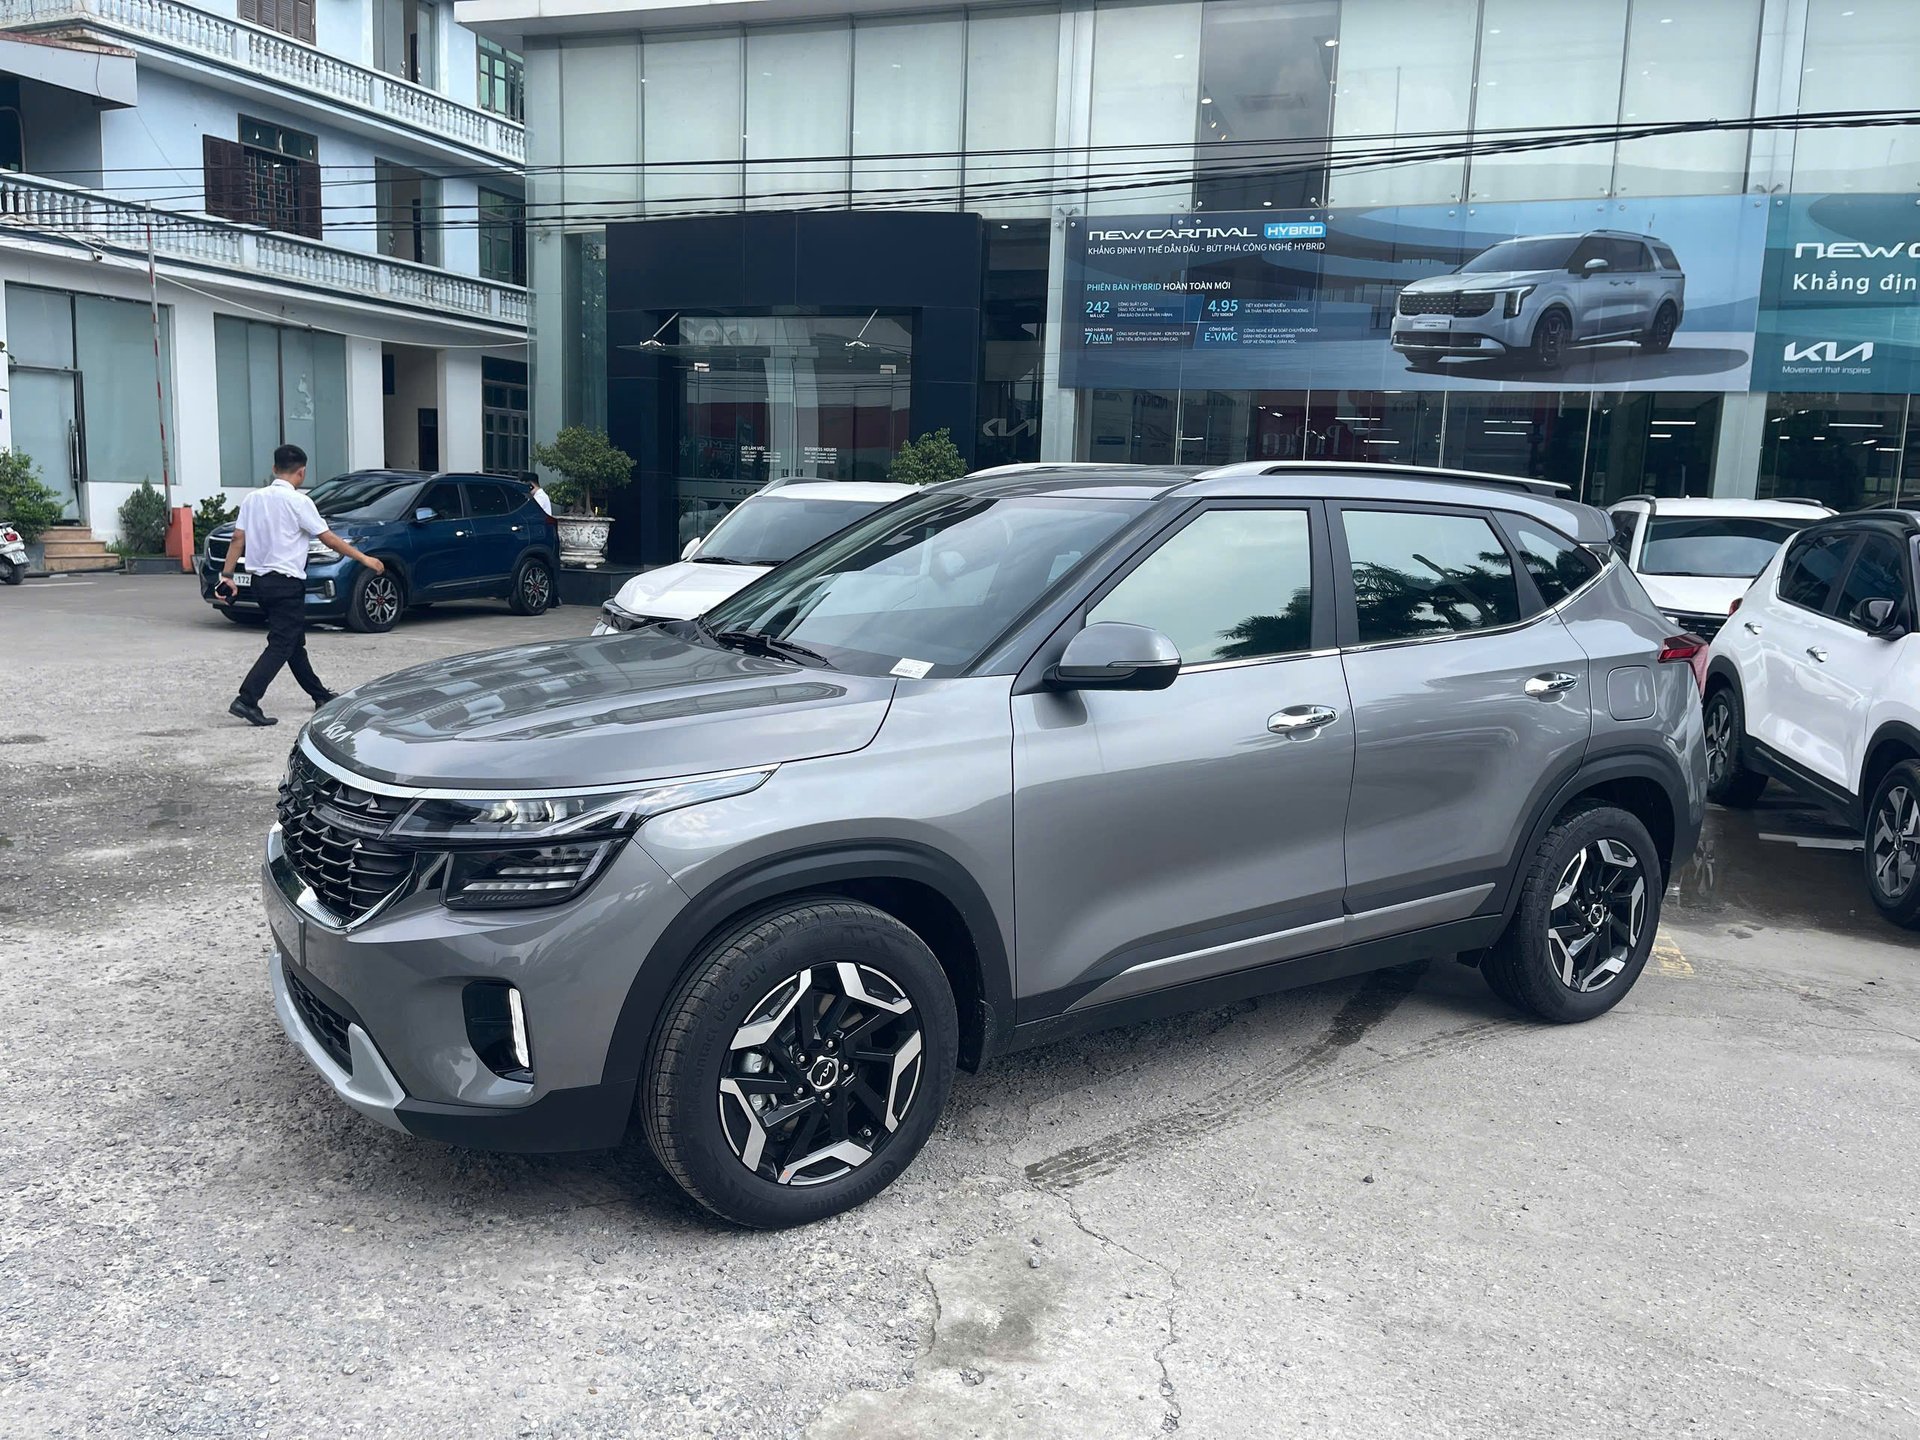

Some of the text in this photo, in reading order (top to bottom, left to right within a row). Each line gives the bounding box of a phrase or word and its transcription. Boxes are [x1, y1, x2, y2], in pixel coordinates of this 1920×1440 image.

[1146, 227, 1258, 239] CARNIVAL
[1267, 225, 1323, 236] HYBRID
[1242, 242, 1267, 252] CÔNG
[1294, 242, 1325, 251] HYBRID
[1087, 282, 1111, 291] PHIÊN
[1131, 283, 1161, 291] HYBRID
[1162, 281, 1188, 291] HOÀN
[1189, 281, 1212, 290] TOÀN
[1793, 270, 1870, 295] Khẳng
[1085, 301, 1109, 313] 242
[1207, 300, 1239, 312] 4.95
[1084, 332, 1113, 344] 7 NĂM
[1204, 332, 1239, 341] E-VMC
[1784, 341, 1874, 362] KIA
[1782, 366, 1871, 375] Movement that inspires
